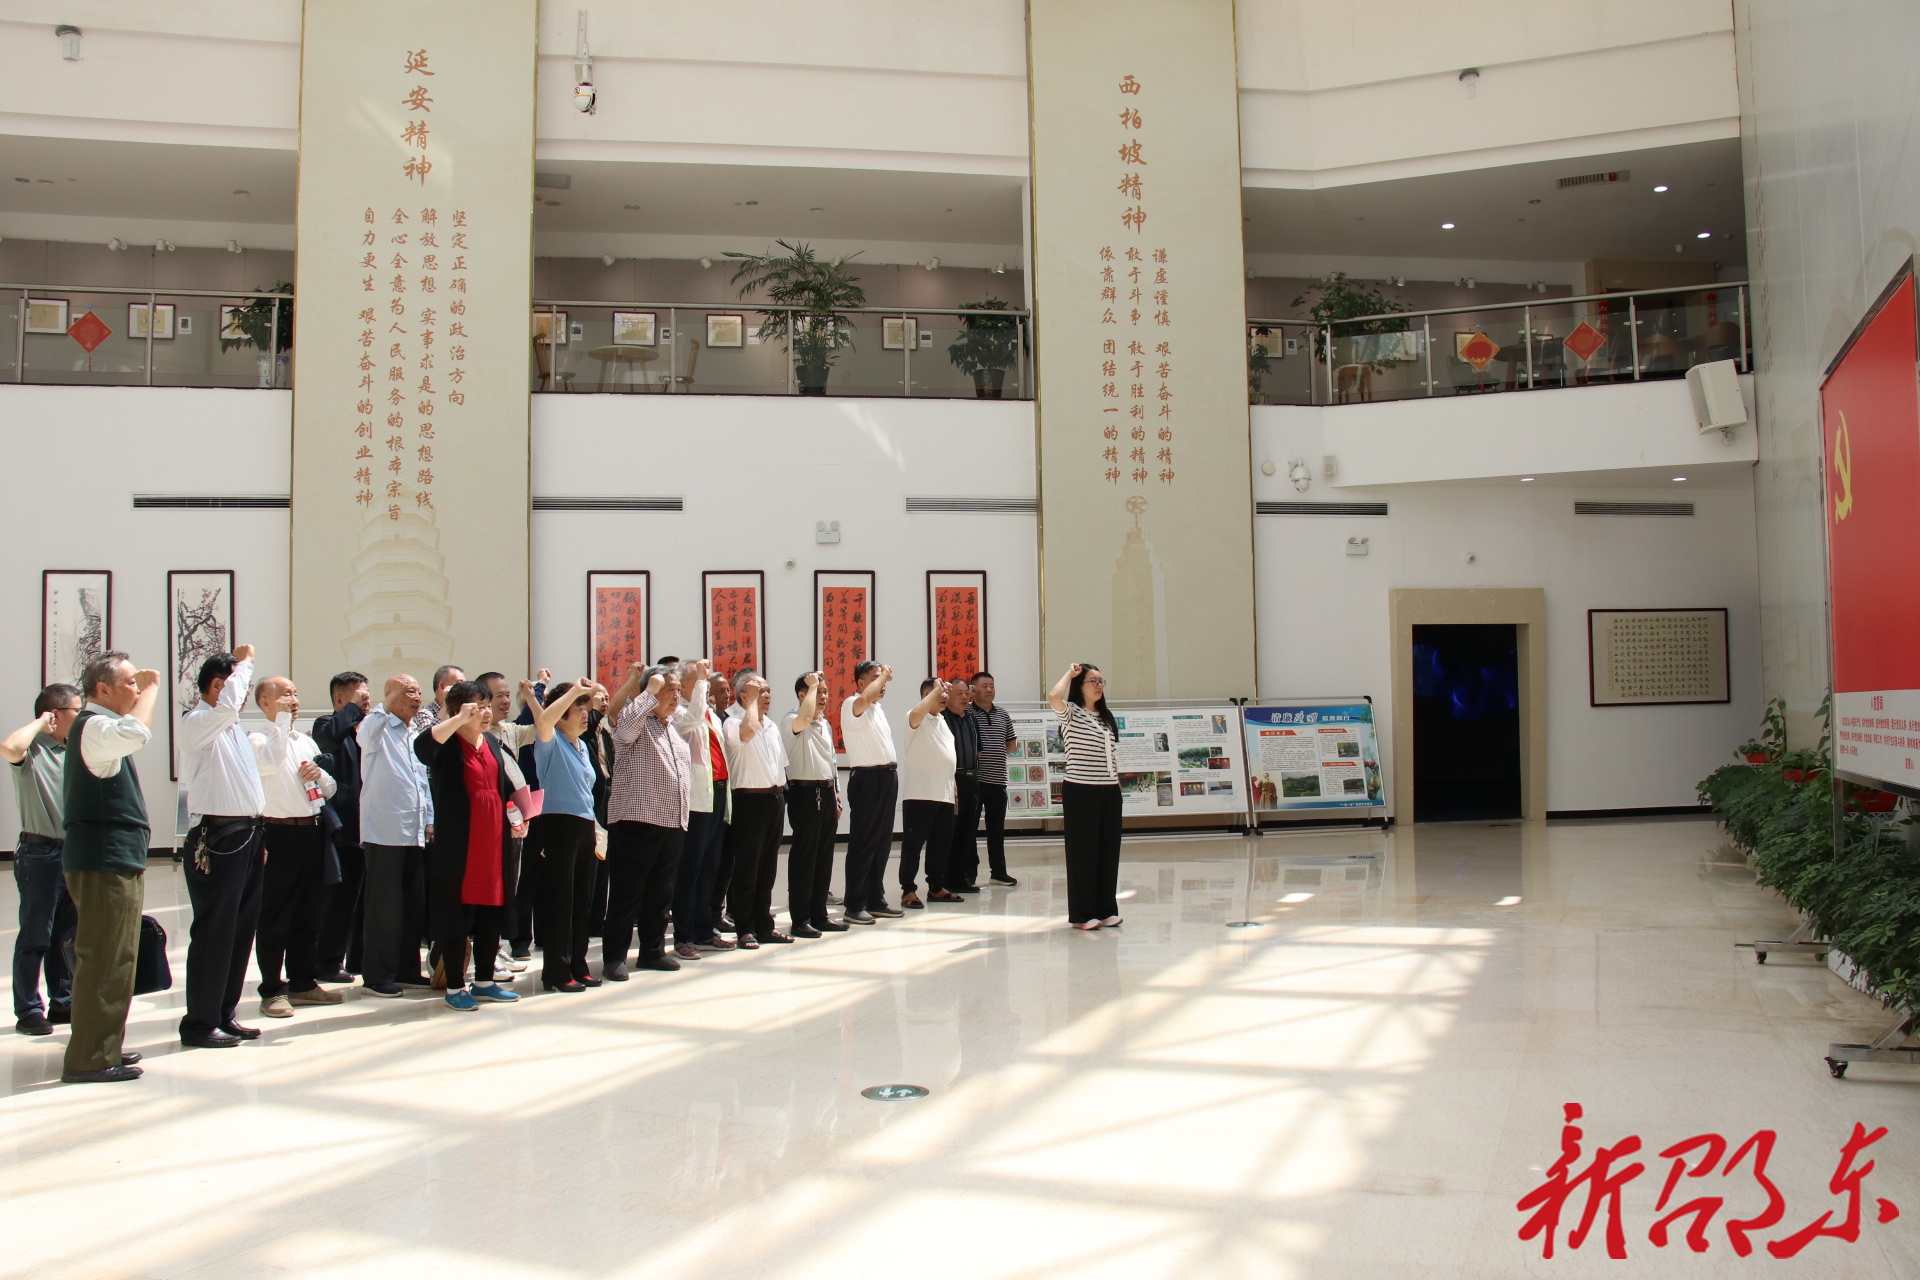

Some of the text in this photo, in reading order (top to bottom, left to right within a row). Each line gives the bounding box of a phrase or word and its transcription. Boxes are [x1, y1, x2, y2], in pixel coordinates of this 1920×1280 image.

[401, 48, 436, 187] 延安精神
[1117, 74, 1148, 236] 西柏坡精神
[353, 206, 378, 509] 自力更生 艰苦奋斗的创业精神
[385, 206, 408, 522] 全心全意为人民服务的根本宗旨
[415, 207, 439, 511] 解放思想 实事求是的思想路线
[448, 209, 469, 407] 坚定正确的政治方向
[1099, 245, 1121, 486] 依靠群众 团结统一的精神
[1124, 245, 1149, 487] 敢于斗争 敢于胜利的精神
[1151, 248, 1176, 487] 谦虚谨慎 艰苦奋斗的精神
